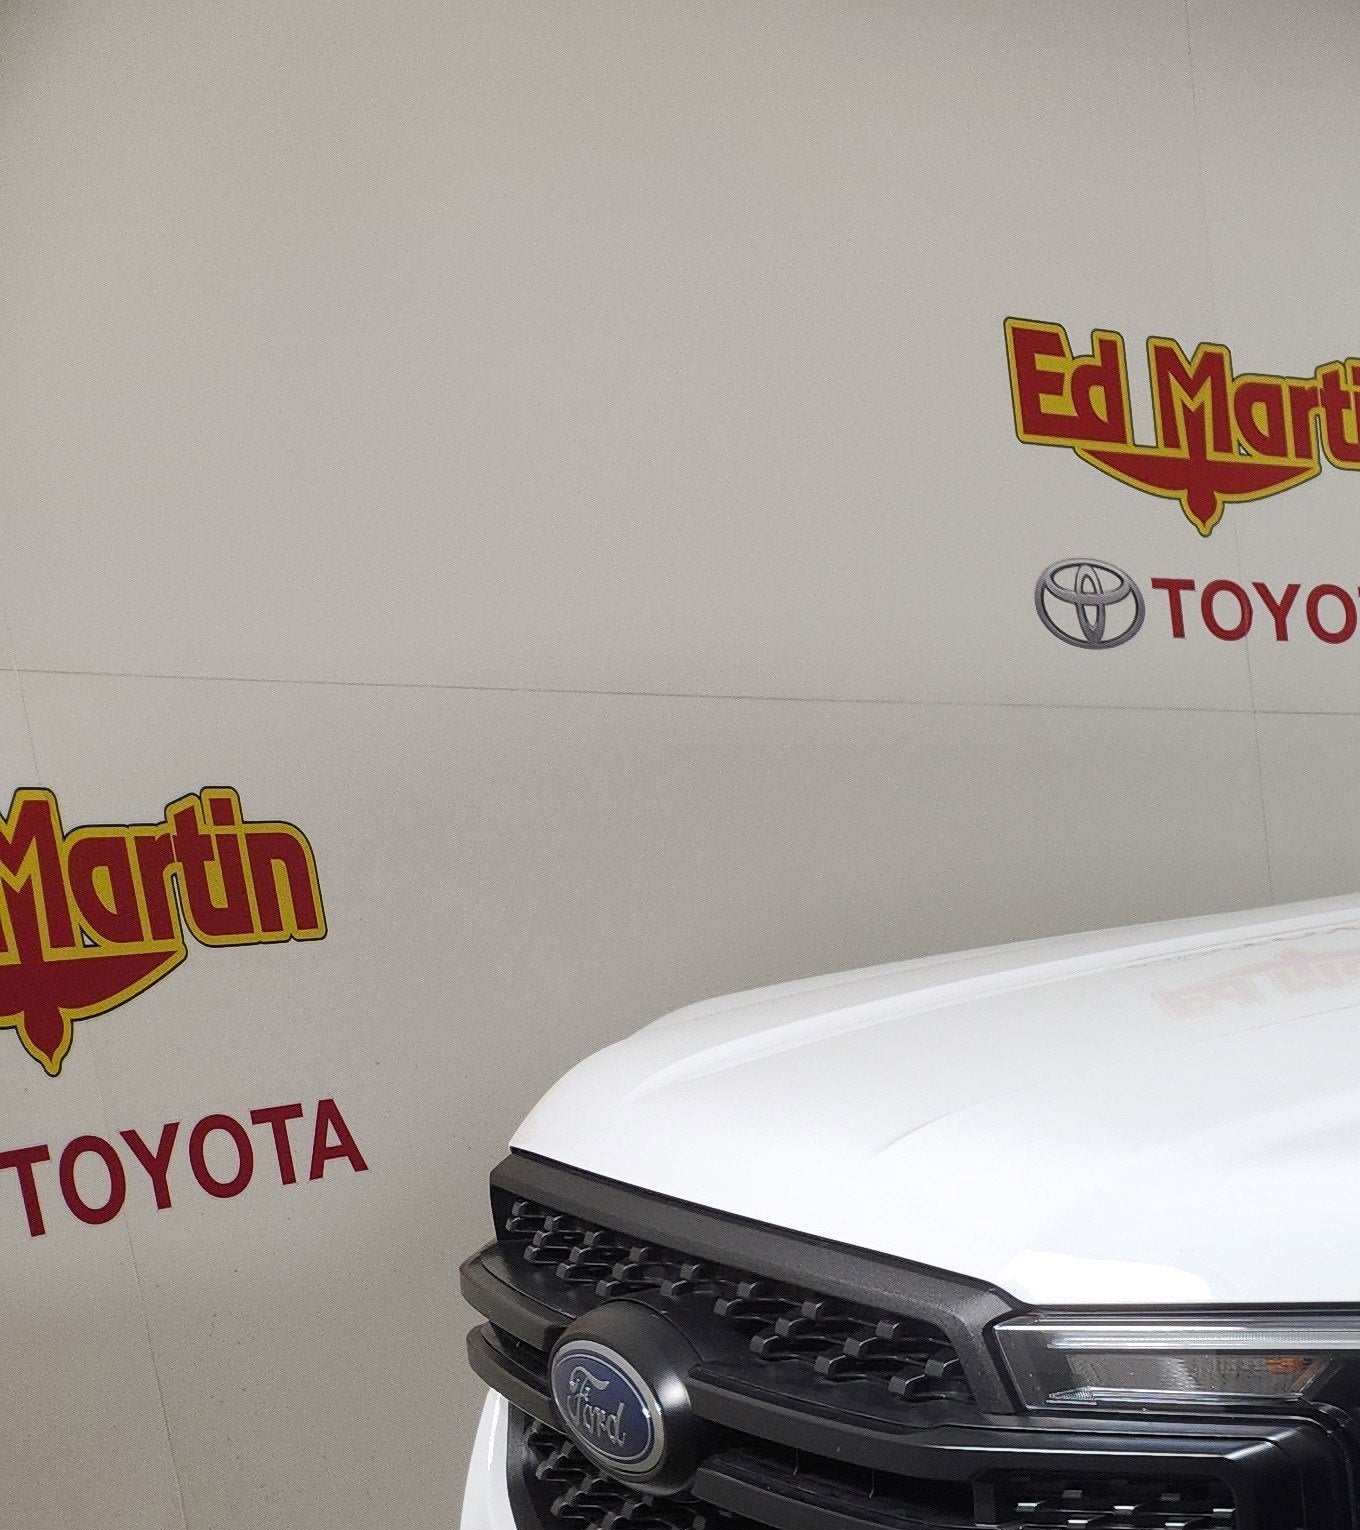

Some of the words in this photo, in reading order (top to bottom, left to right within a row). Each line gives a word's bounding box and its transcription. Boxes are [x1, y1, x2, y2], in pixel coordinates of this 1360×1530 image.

[1004, 317, 1130, 449] Ed
[0, 786, 328, 950] Martin
[0, 1098, 369, 1238] TOYOTA
[566, 1365, 628, 1447] Ford
